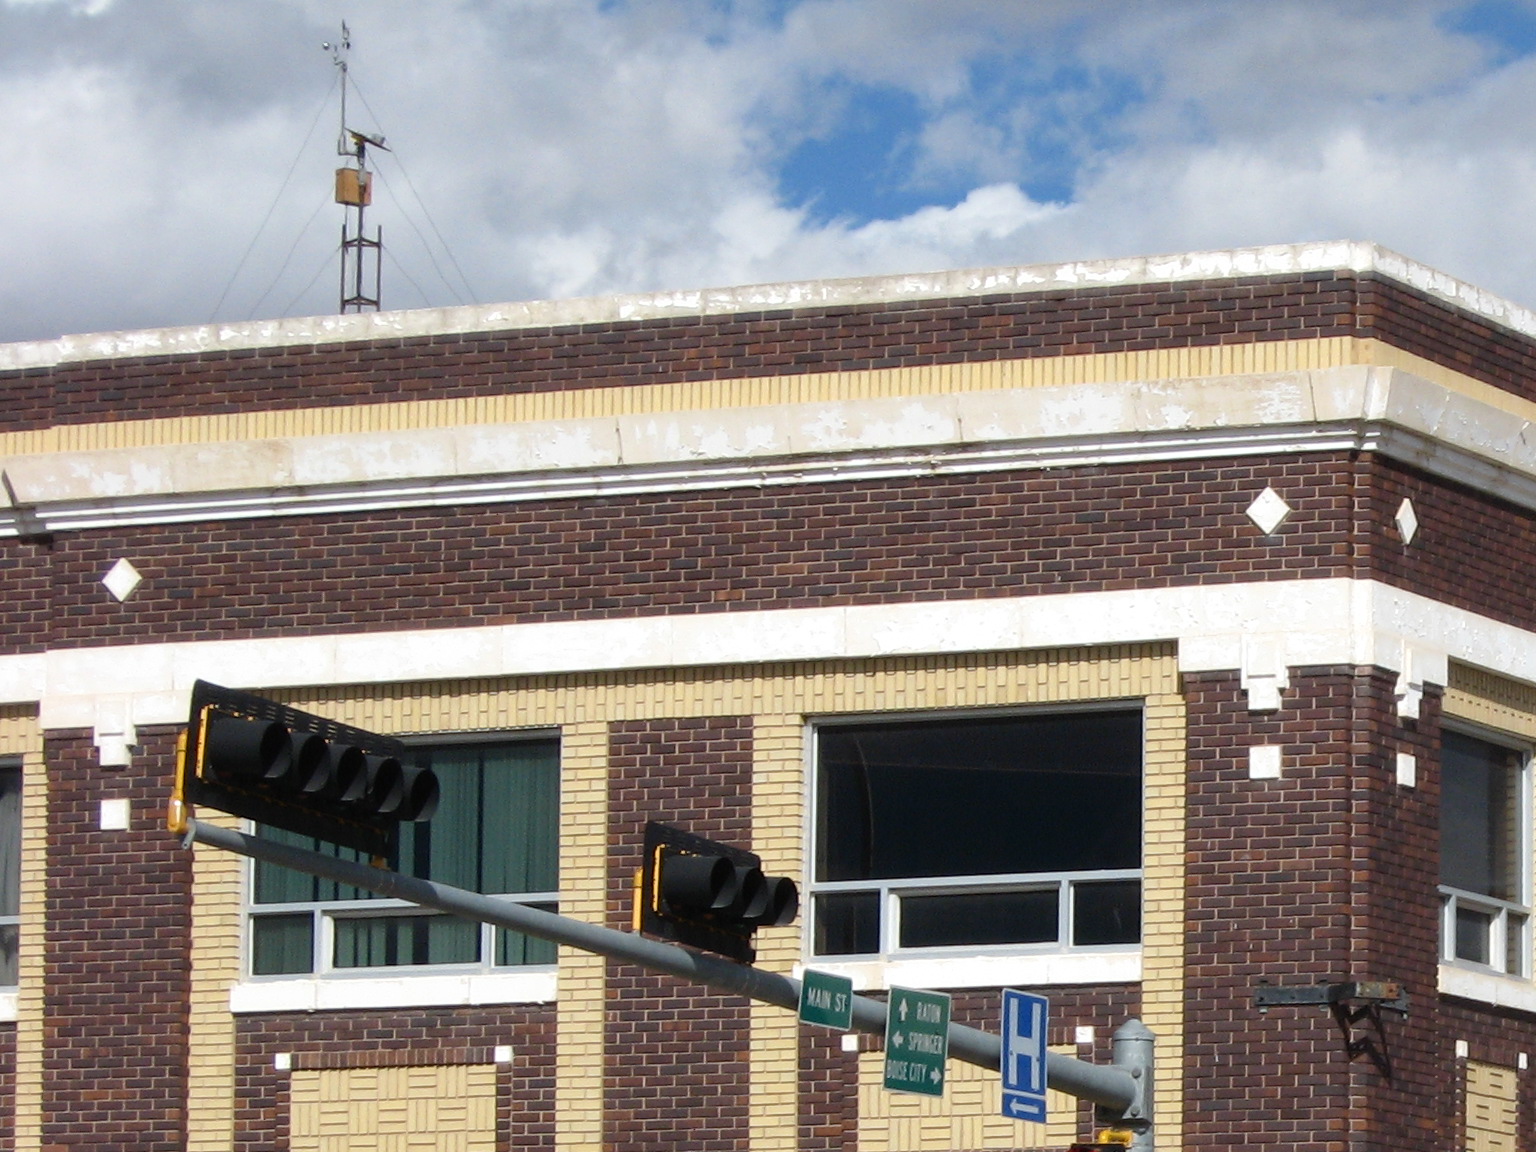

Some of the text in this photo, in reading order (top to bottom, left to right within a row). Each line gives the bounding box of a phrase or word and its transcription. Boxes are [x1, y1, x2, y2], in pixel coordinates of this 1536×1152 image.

[807, 987, 847, 1012] MAIN ST
[916, 1001, 941, 1023] RATON
[908, 1031, 944, 1055] SPRINGER
[1008, 997, 1041, 1091] H
[887, 1059, 928, 1083] BOISE CITY
